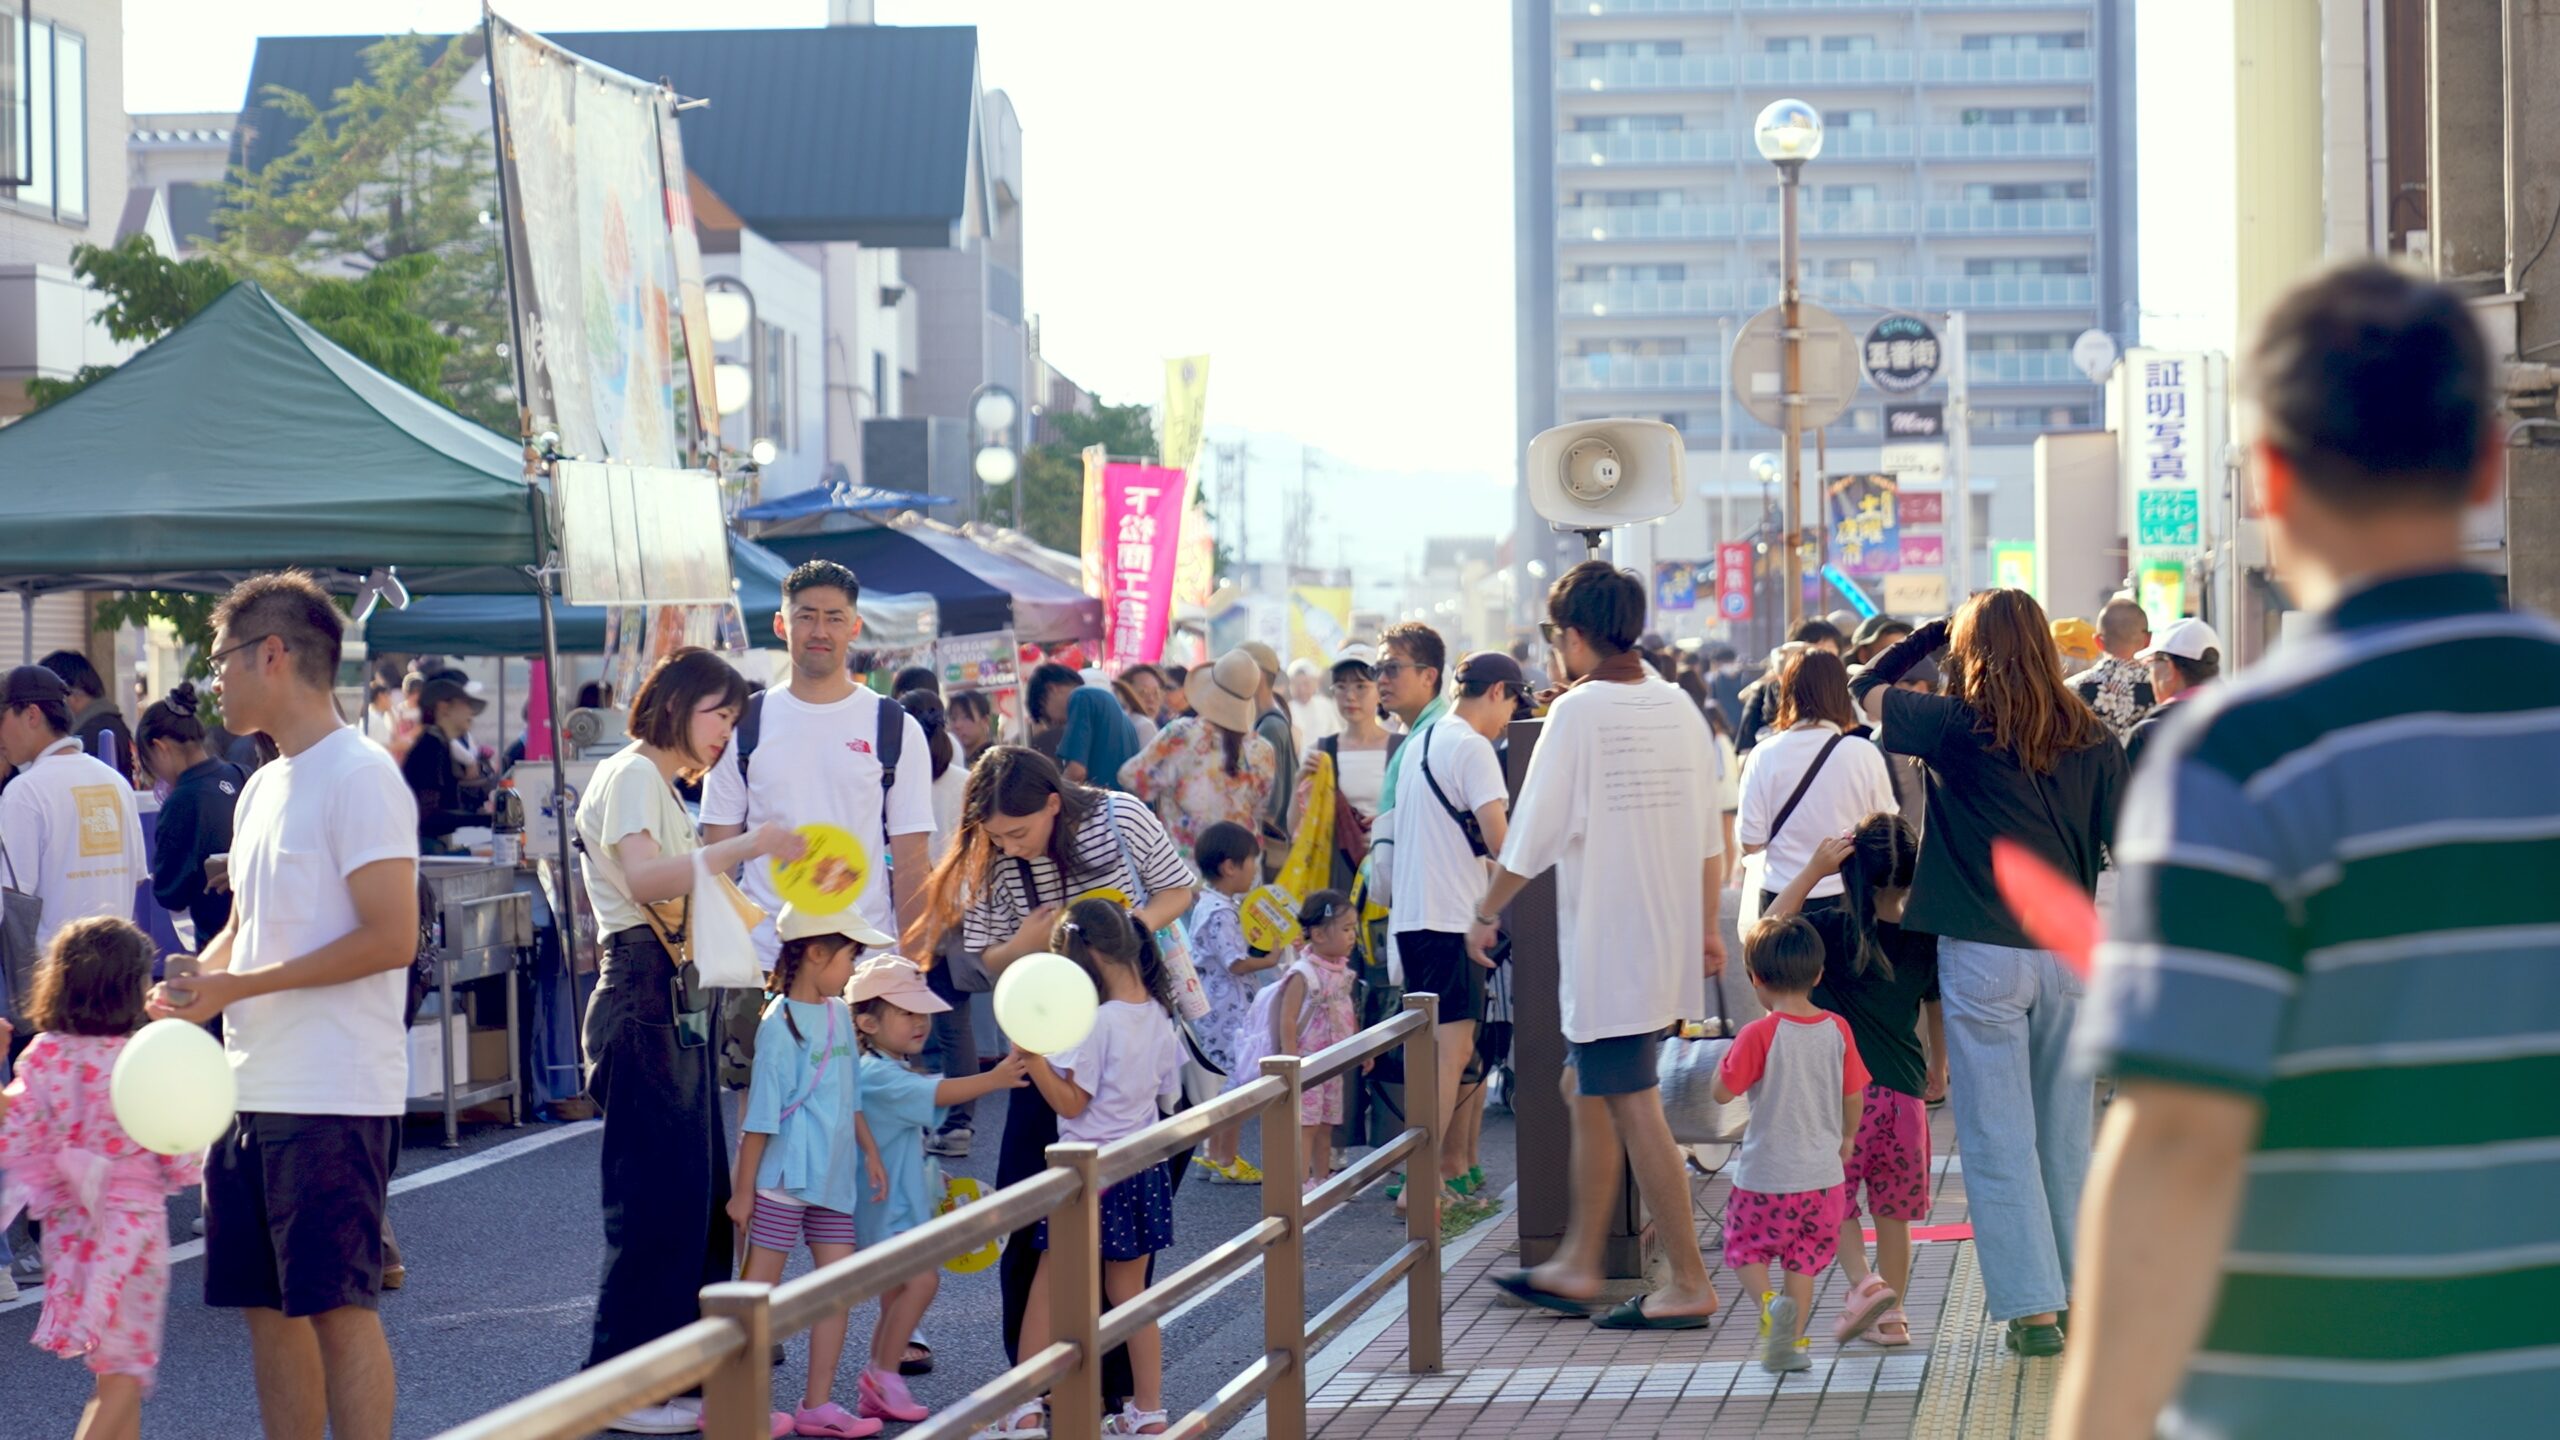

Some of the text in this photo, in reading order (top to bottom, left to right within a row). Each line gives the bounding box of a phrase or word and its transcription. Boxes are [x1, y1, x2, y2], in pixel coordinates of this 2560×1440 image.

[1868, 339, 1936, 369] 五番街
[2146, 361, 2185, 479] 証明写真
